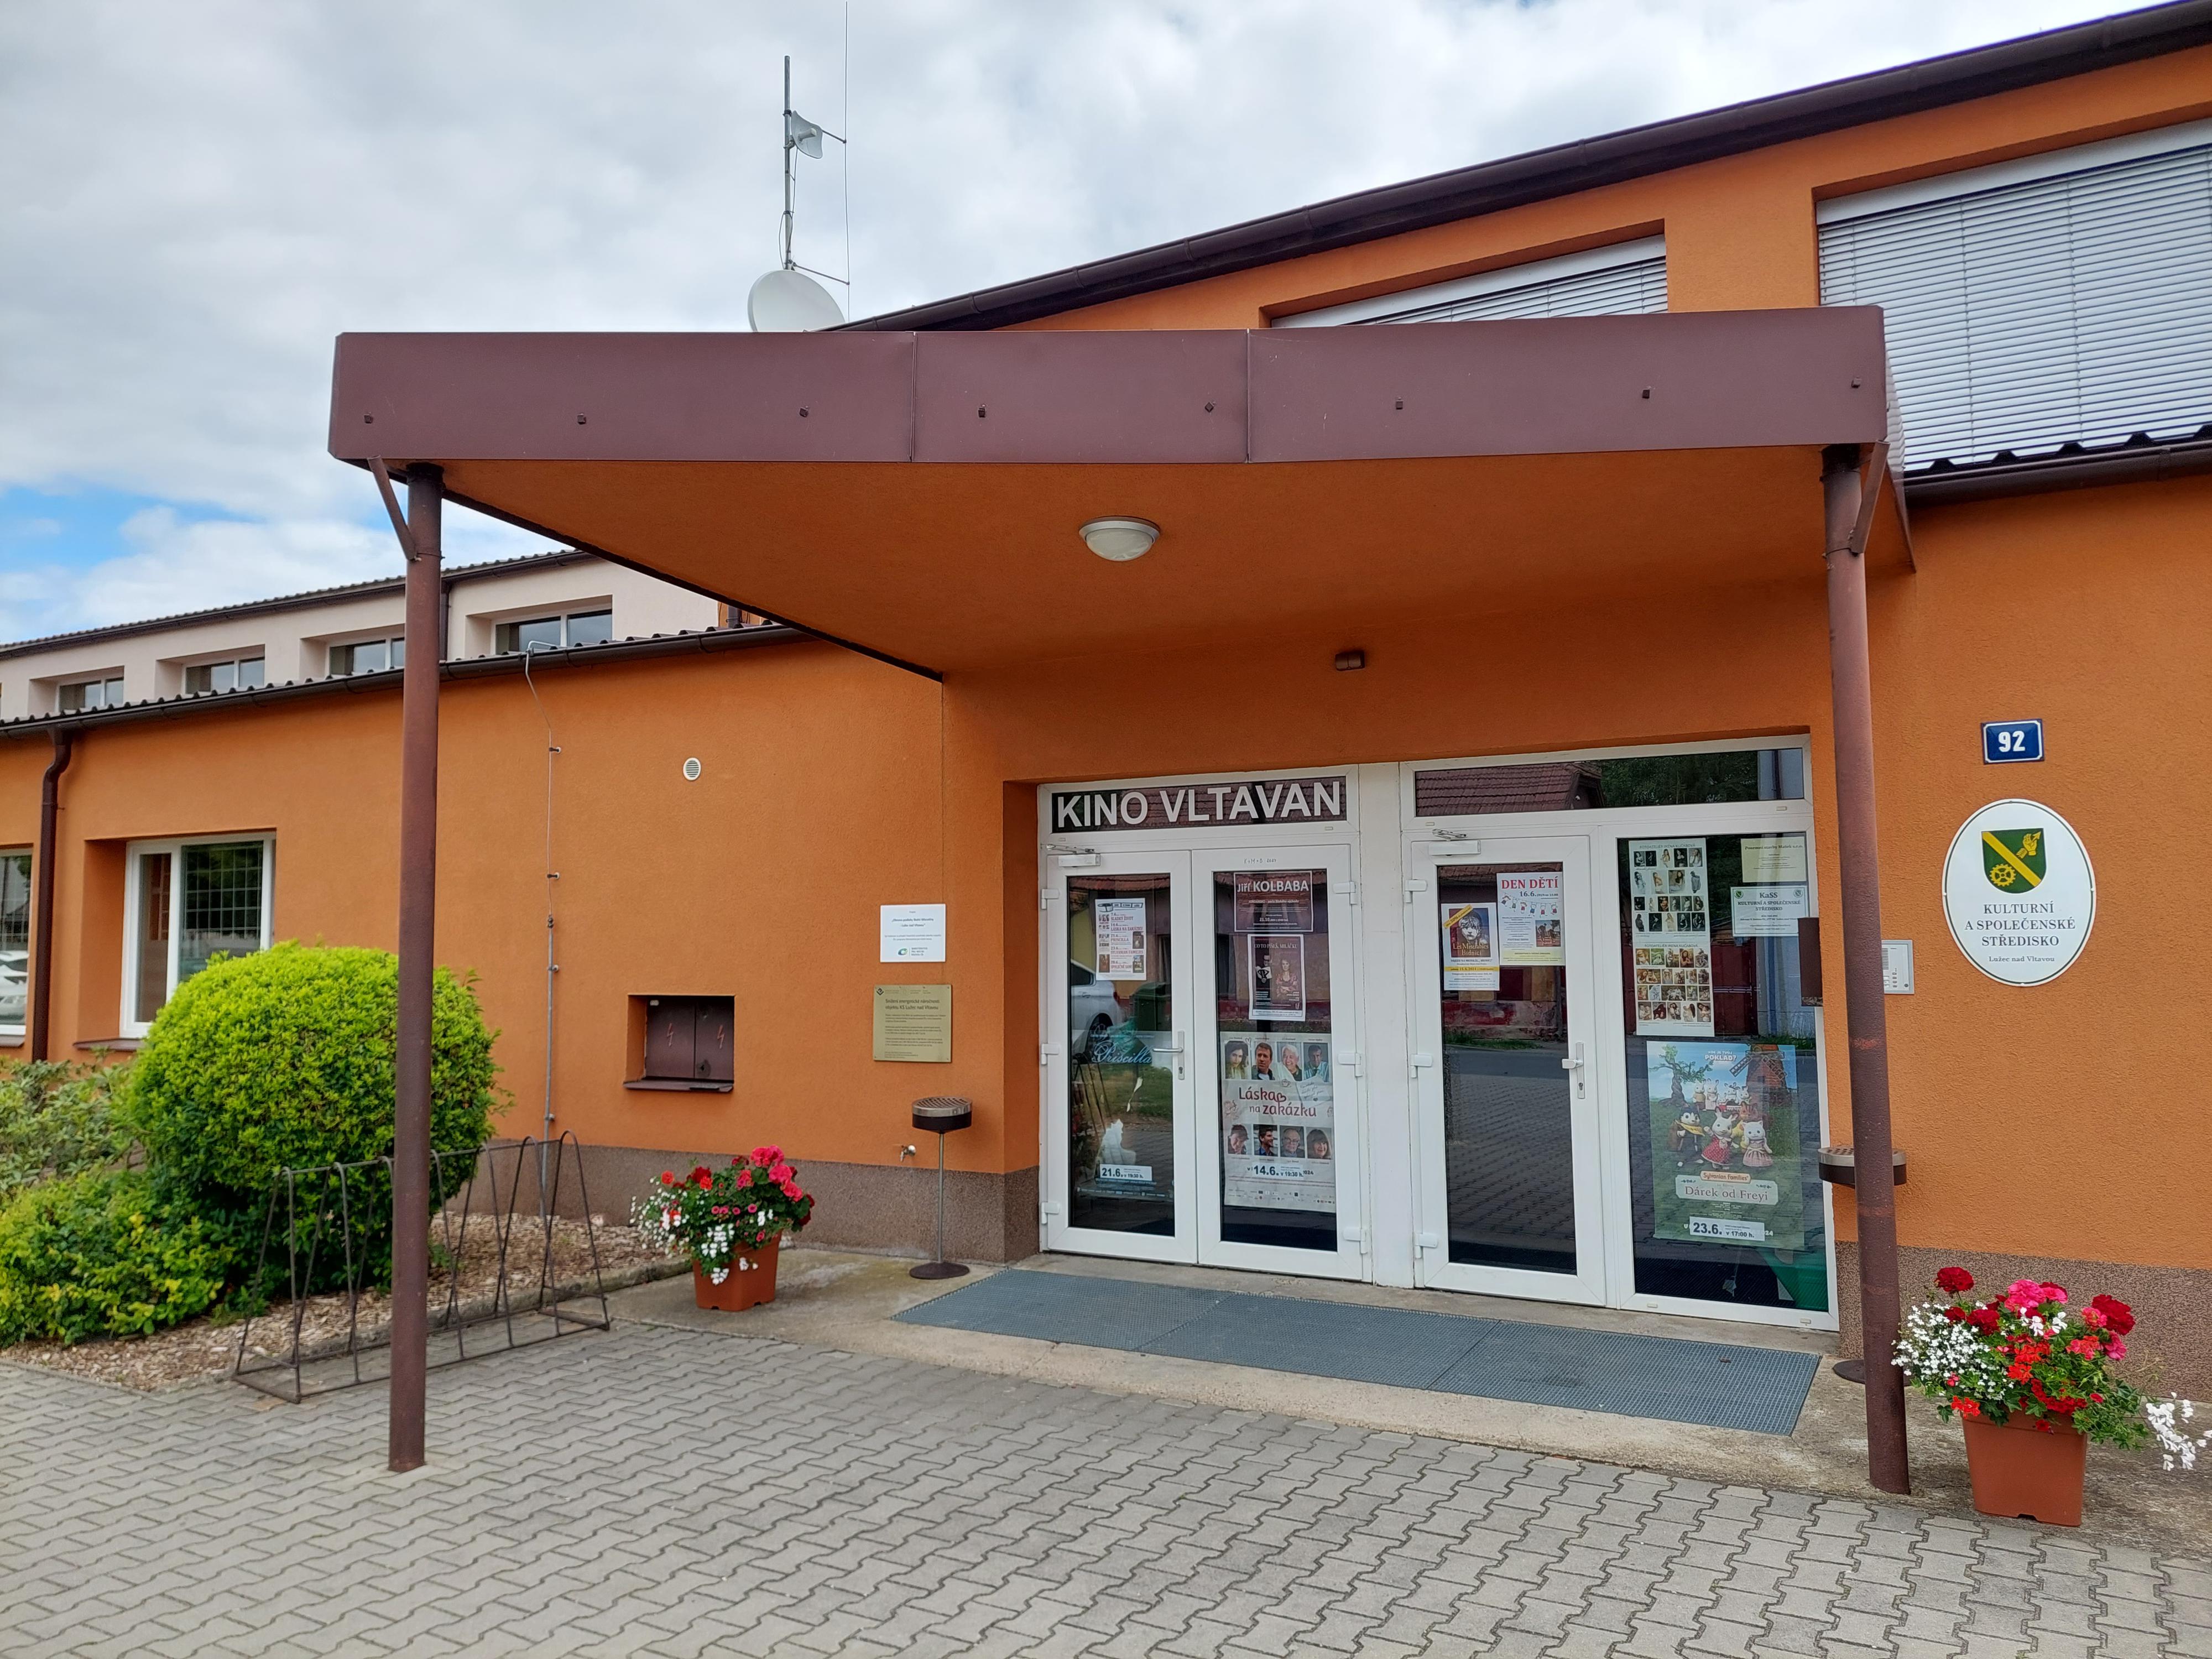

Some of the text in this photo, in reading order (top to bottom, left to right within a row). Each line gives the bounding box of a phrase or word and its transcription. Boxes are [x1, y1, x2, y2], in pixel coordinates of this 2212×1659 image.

[1999, 731, 2025, 752] 92
[1057, 781, 1340, 828] KINO VLTAVAN
[1237, 880, 1309, 892] Jiří KOLBABA
[1501, 876, 1558, 889] DEN DĚTÍ
[1984, 901, 2054, 914] KULTURNÍ
[1964, 916, 2075, 930] A SPOLEČENSKÉ
[1982, 934, 2059, 946] STŘEDISKO
[1092, 1040, 1152, 1063] Priscilla
[1239, 1086, 1279, 1101] Láska
[1262, 1102, 1317, 1117] zakázku
[1254, 1165, 1279, 1176] 14.6.
[1685, 1186, 1768, 1202] Dárek od Freyi
[1693, 1222, 1722, 1235] 23.6.
